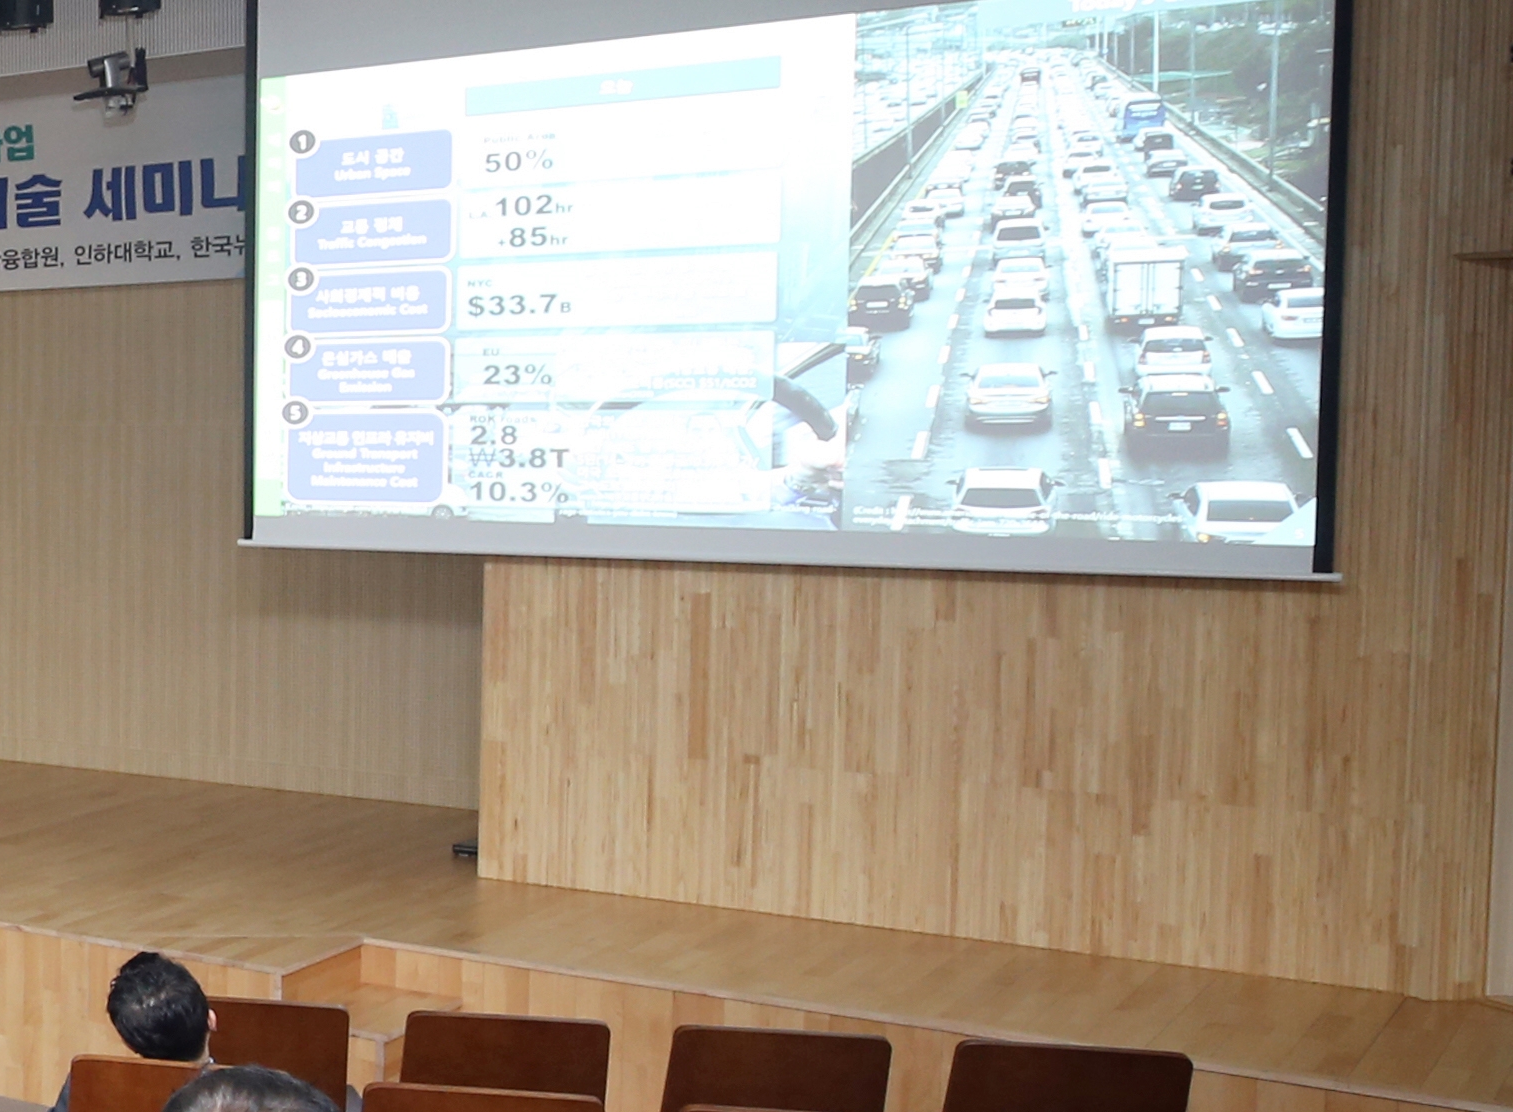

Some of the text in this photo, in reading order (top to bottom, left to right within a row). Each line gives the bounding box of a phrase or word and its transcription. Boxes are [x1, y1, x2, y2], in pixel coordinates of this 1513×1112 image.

[485, 148, 554, 173] 50%
[74, 238, 181, 266] 인하대학교,
[483, 365, 552, 386] 23%
[470, 426, 518, 446] 2.8
[470, 481, 570, 503] 10.3%
